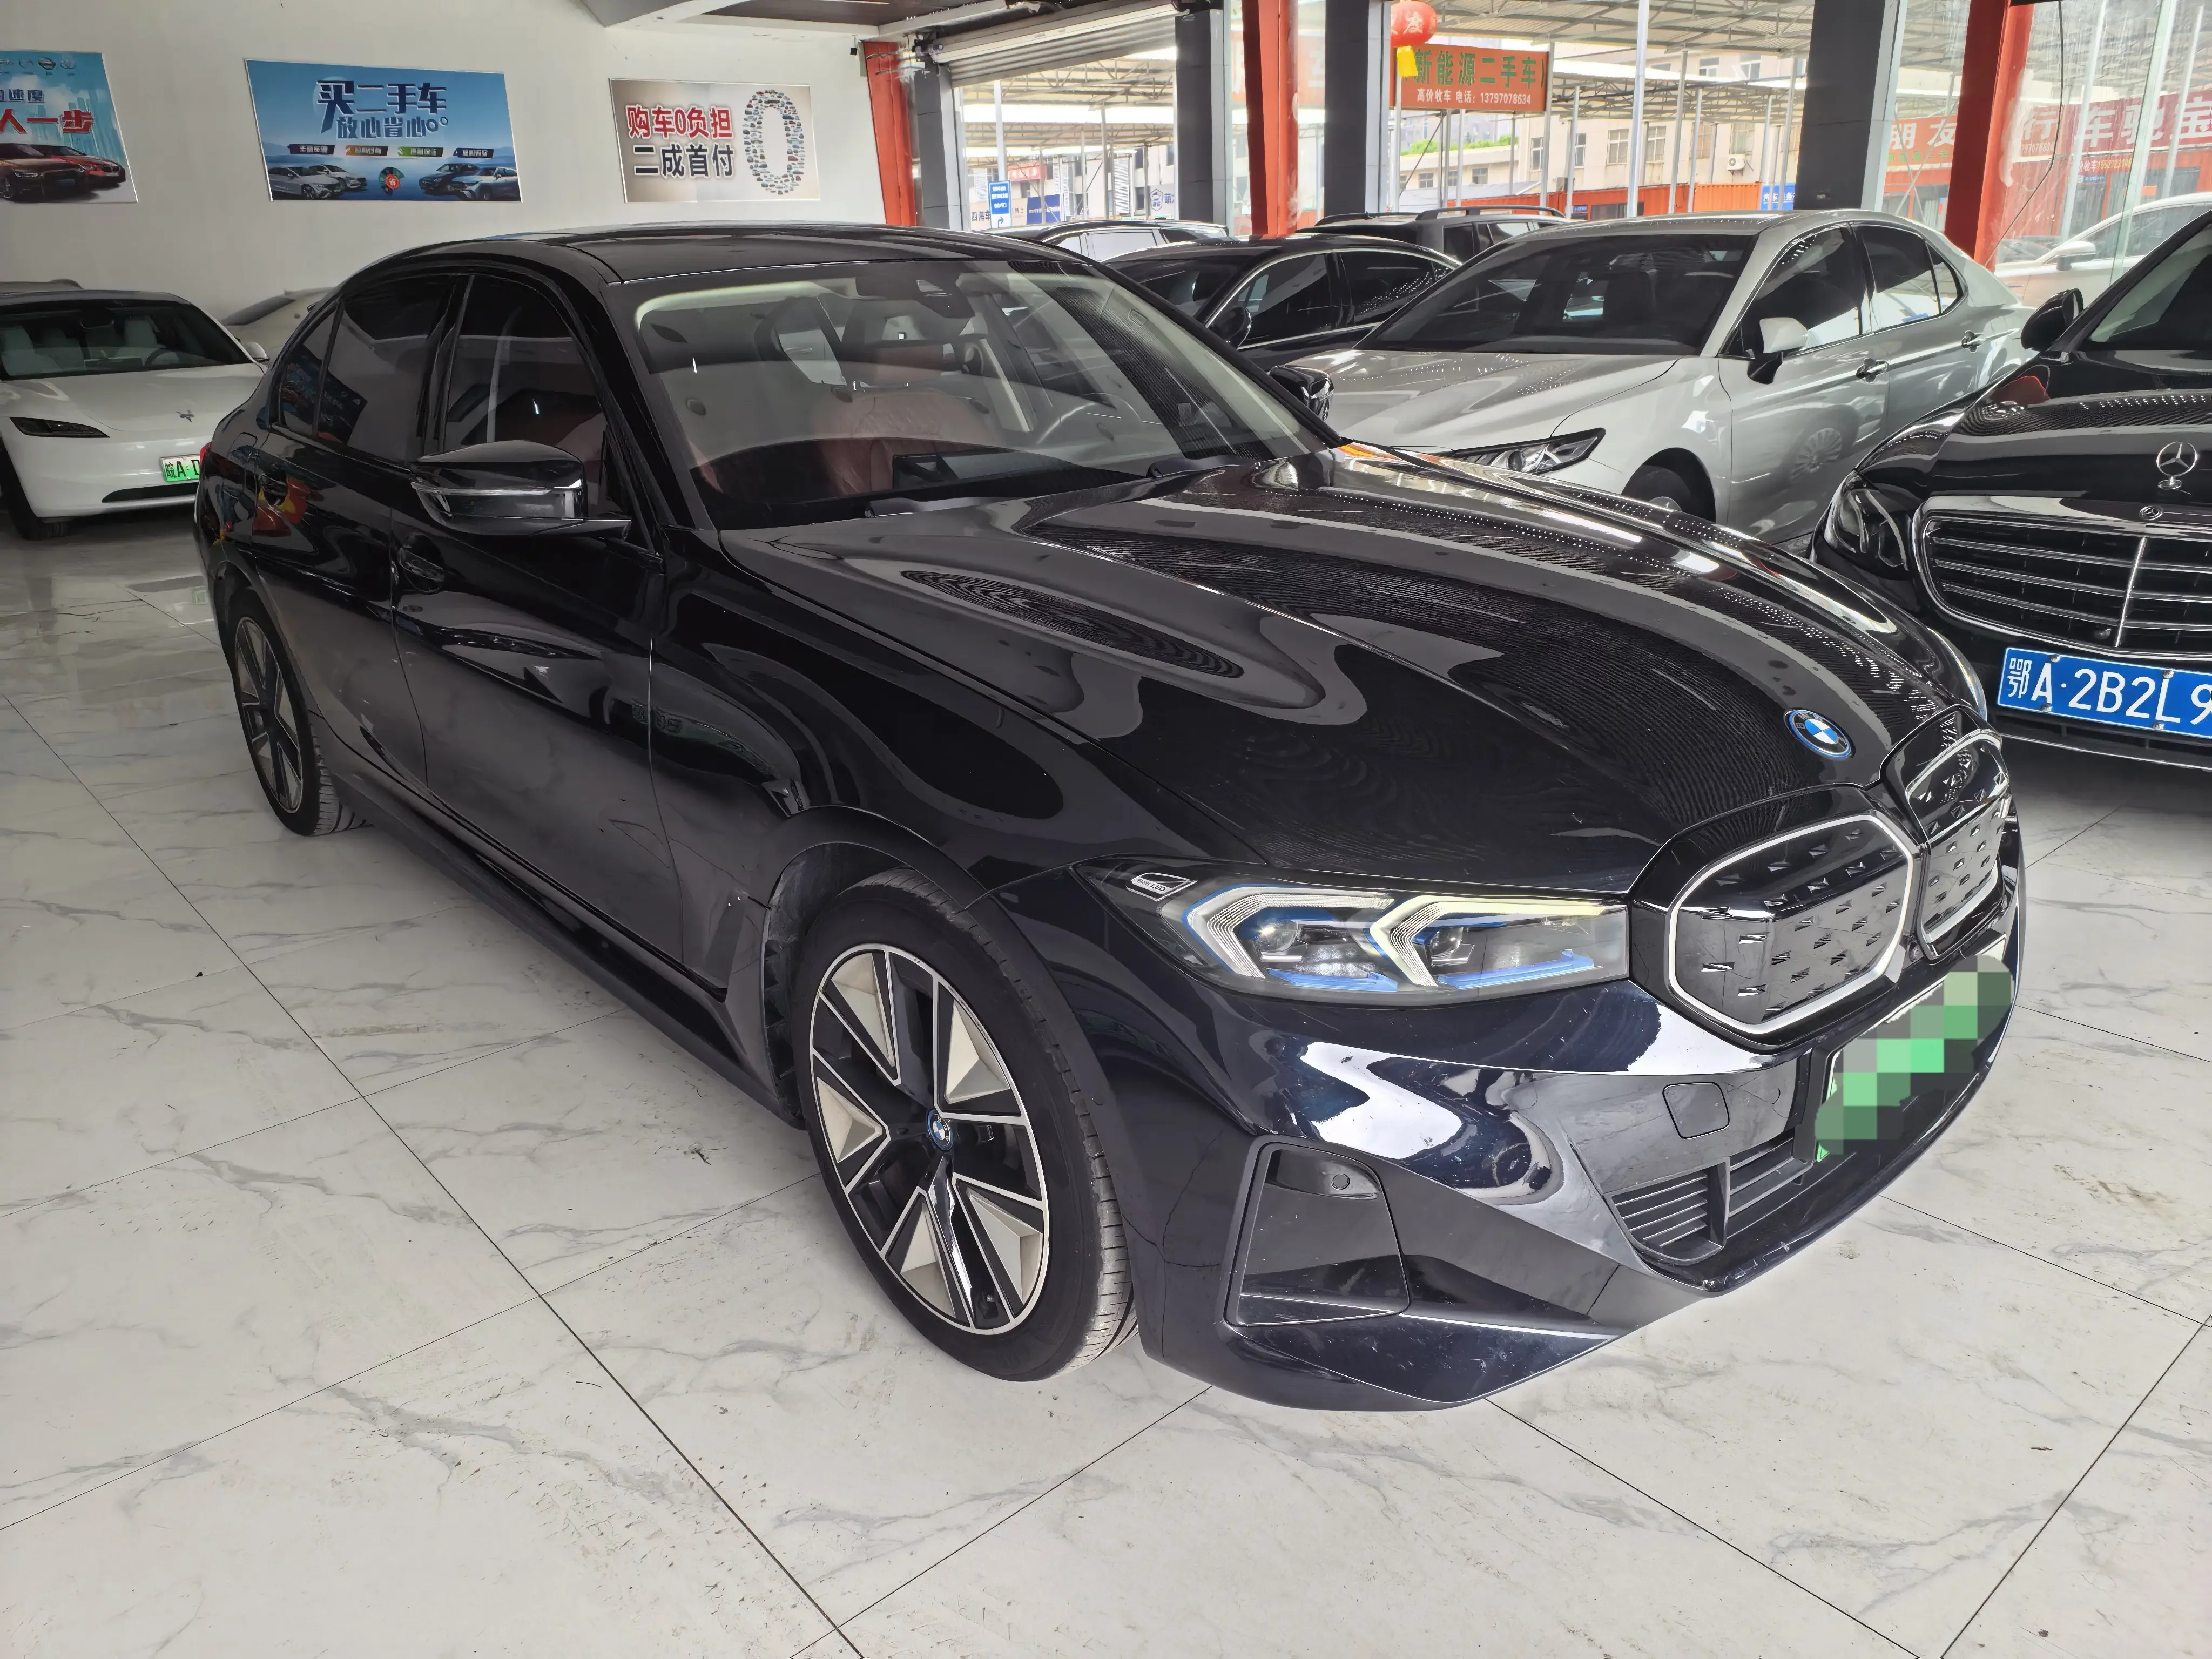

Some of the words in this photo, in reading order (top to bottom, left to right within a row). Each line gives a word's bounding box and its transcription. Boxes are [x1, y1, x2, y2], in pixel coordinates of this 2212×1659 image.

[316, 80, 447, 133] 买二手车
[1417, 89, 1451, 103] 高价收车
[1480, 92, 1531, 104] 13797078634
[626, 105, 733, 139] 购车0负担
[1891, 119, 1957, 150] 朋友
[634, 144, 733, 177] 二成首付
[1137, 878, 1150, 886] BMW
